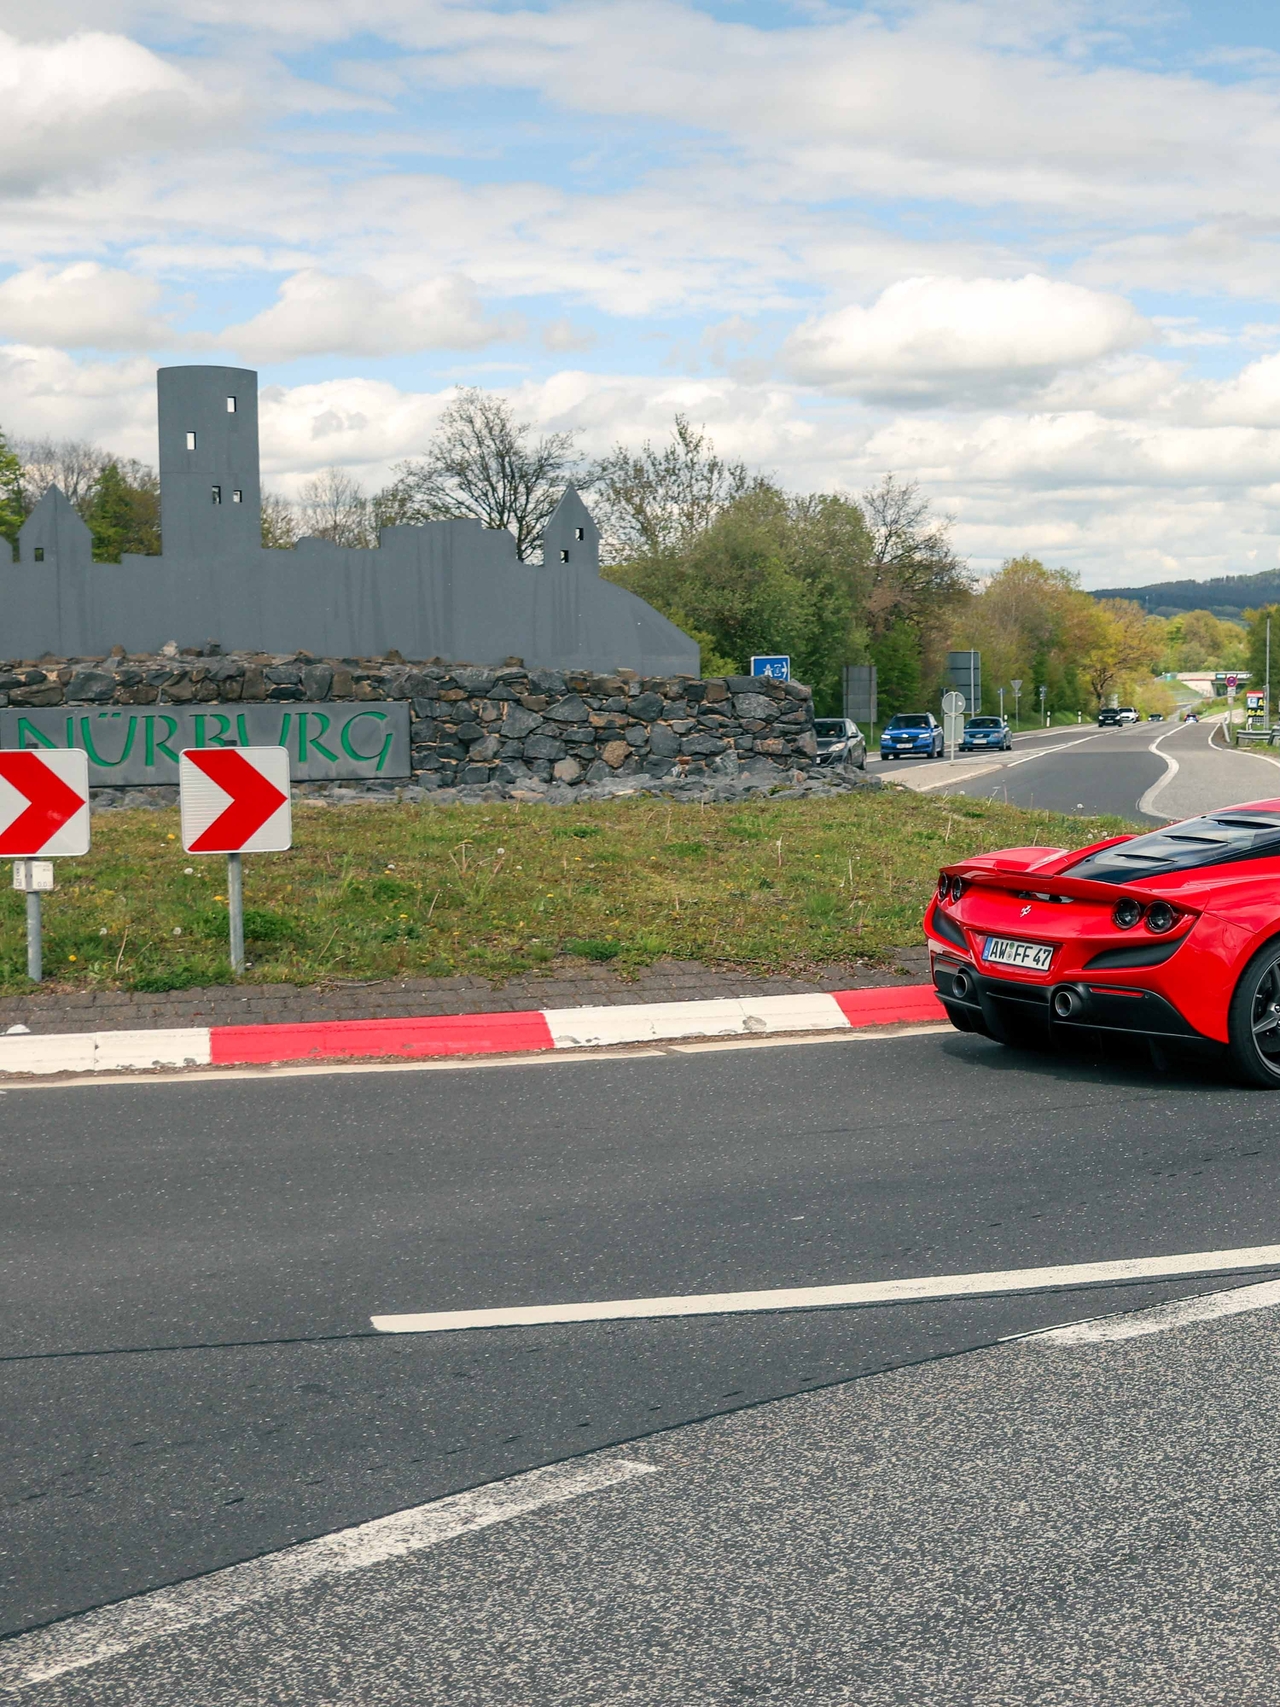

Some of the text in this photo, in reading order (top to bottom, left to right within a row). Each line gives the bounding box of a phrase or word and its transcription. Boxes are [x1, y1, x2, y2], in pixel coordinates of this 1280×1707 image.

[17, 711, 393, 772] NÜRBURG
[990, 940, 1052, 967] AW FF 47
